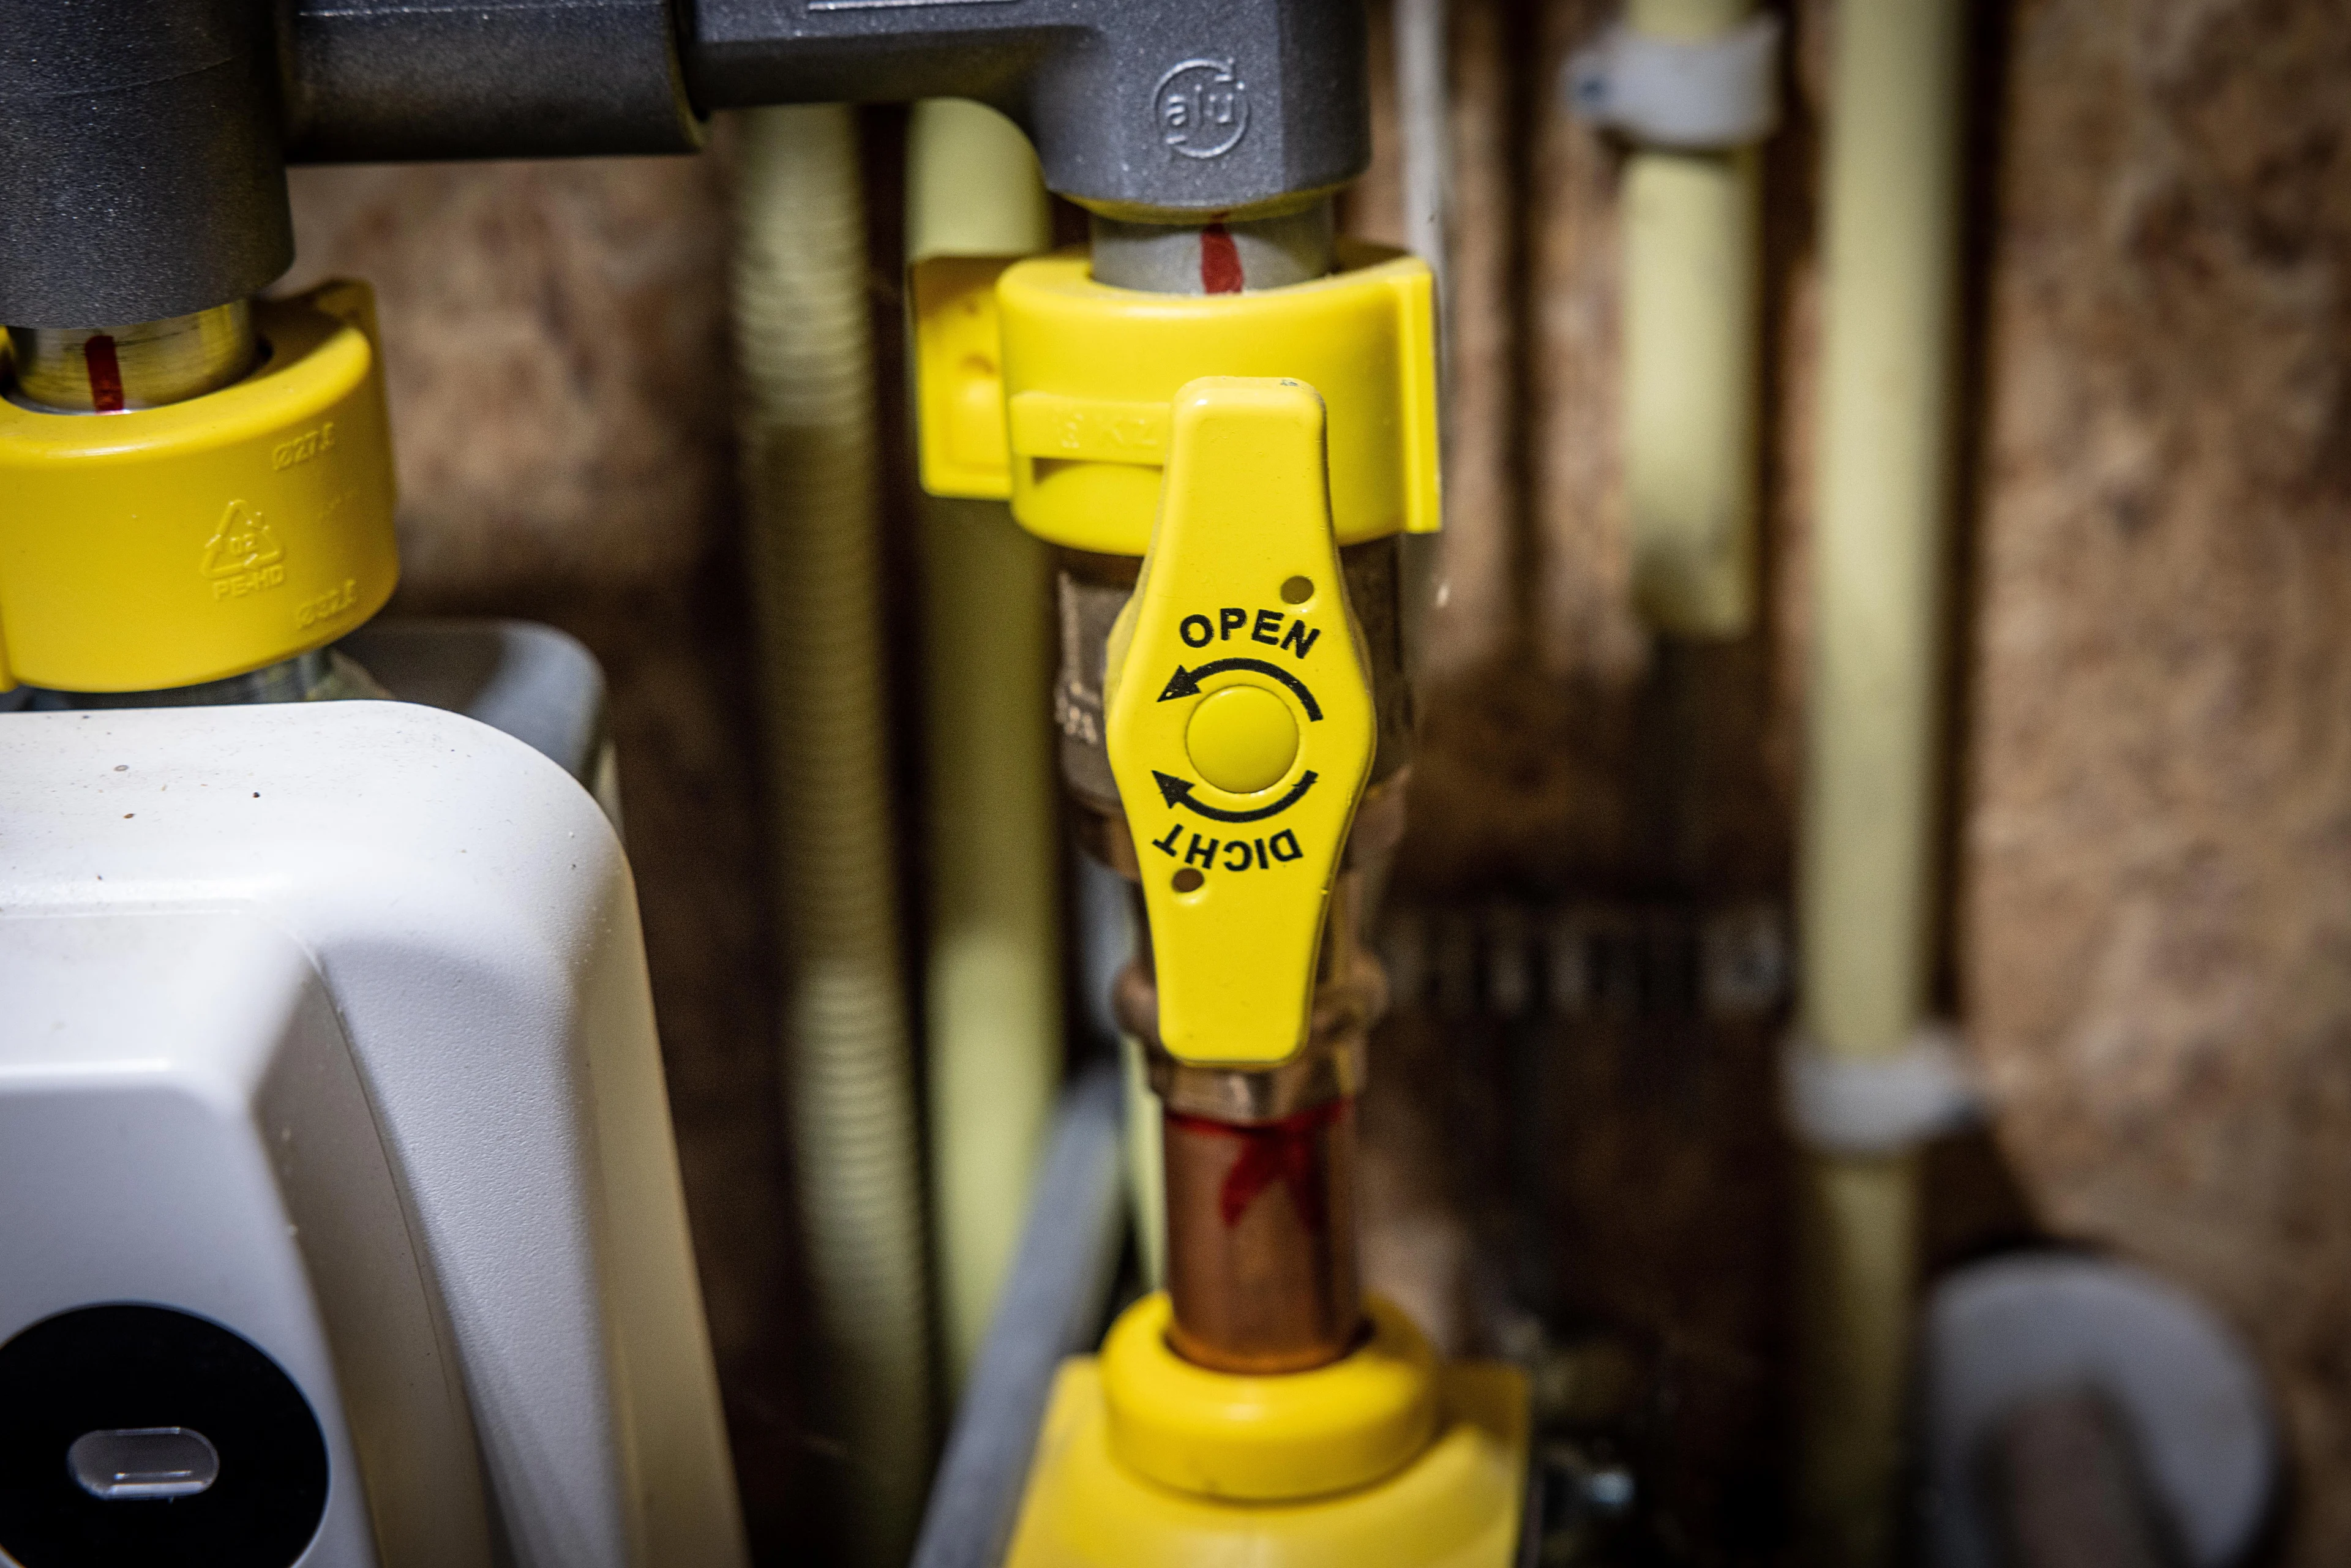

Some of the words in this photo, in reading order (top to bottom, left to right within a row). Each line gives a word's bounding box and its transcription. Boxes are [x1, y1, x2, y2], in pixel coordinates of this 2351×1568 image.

[213, 565, 284, 600] PE-HD
[1180, 607, 1321, 659] OPEN
[1152, 823, 1303, 872] DICHT
